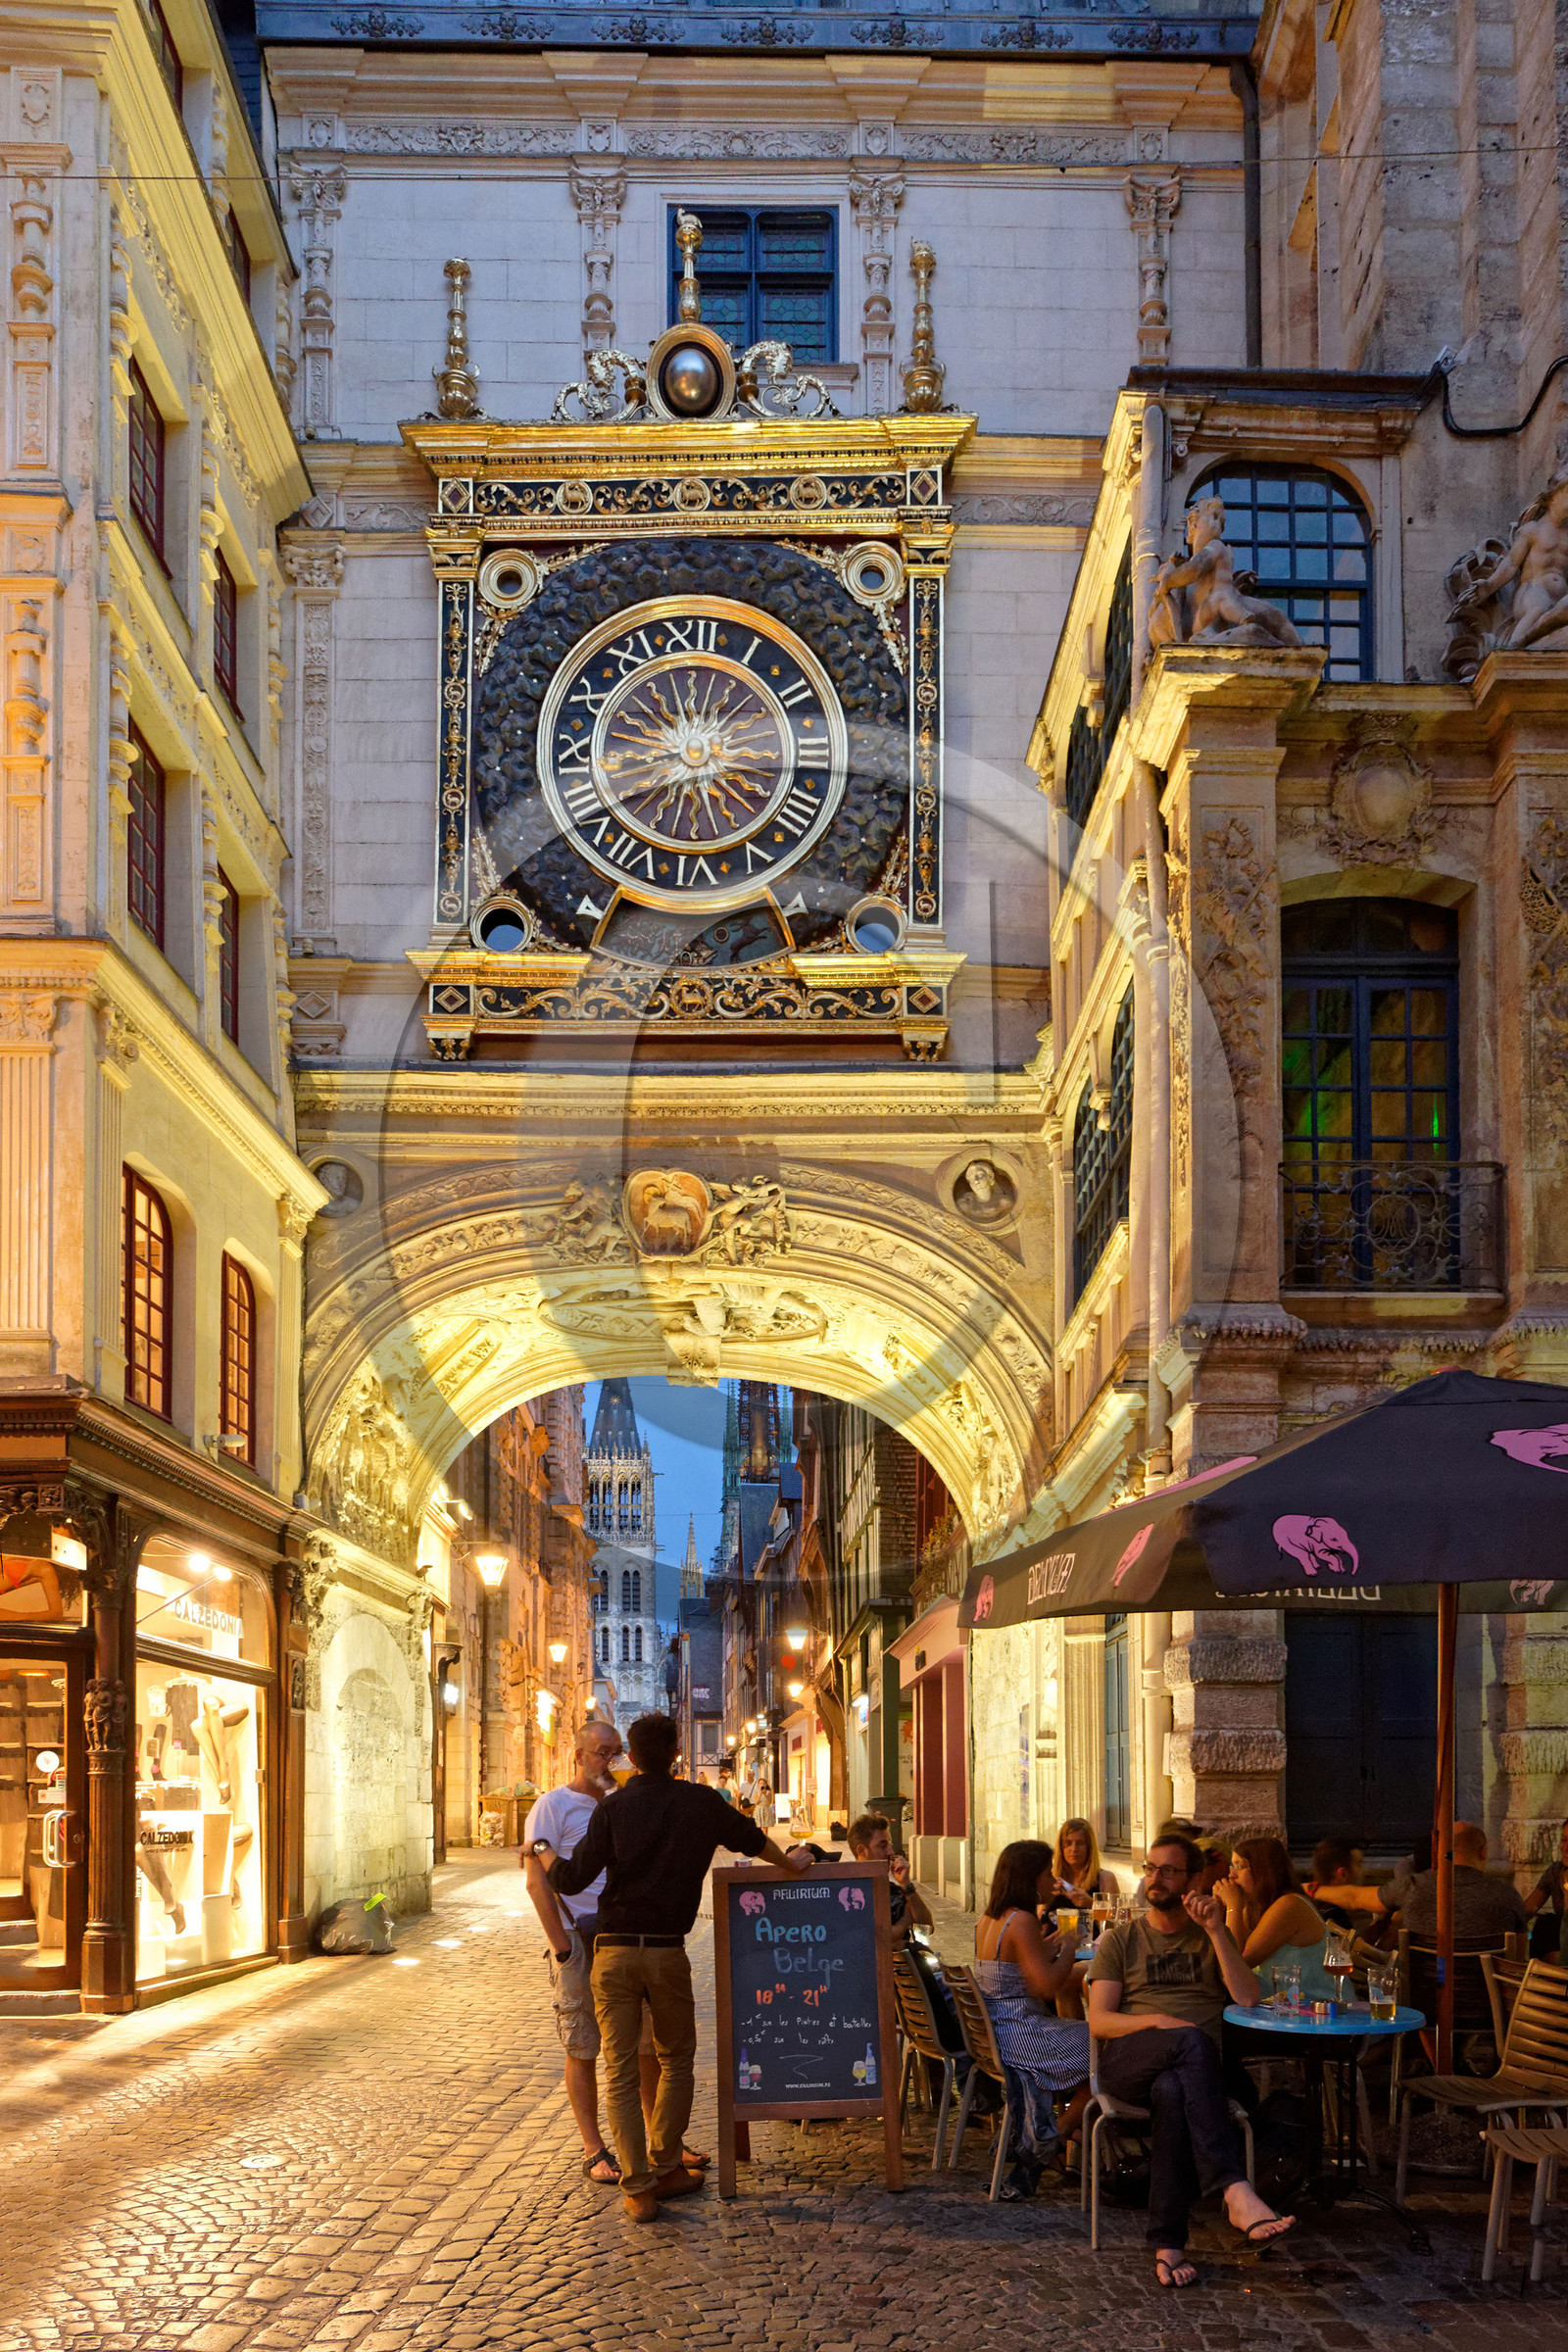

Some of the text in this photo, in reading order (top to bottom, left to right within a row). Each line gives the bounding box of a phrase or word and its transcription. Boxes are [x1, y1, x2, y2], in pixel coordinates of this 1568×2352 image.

[606, 629, 657, 676] XI
[662, 619, 718, 653] XII
[569, 676, 611, 716] X
[778, 677, 813, 710] II
[559, 733, 591, 775] IX
[798, 736, 829, 769] III
[563, 780, 611, 848] VIII
[607, 832, 657, 880] VII
[675, 856, 719, 887] VI
[745, 842, 775, 874] V
[174, 1598, 245, 1639] CALZEDONIA
[773, 1887, 830, 1900] DELIRIUM
